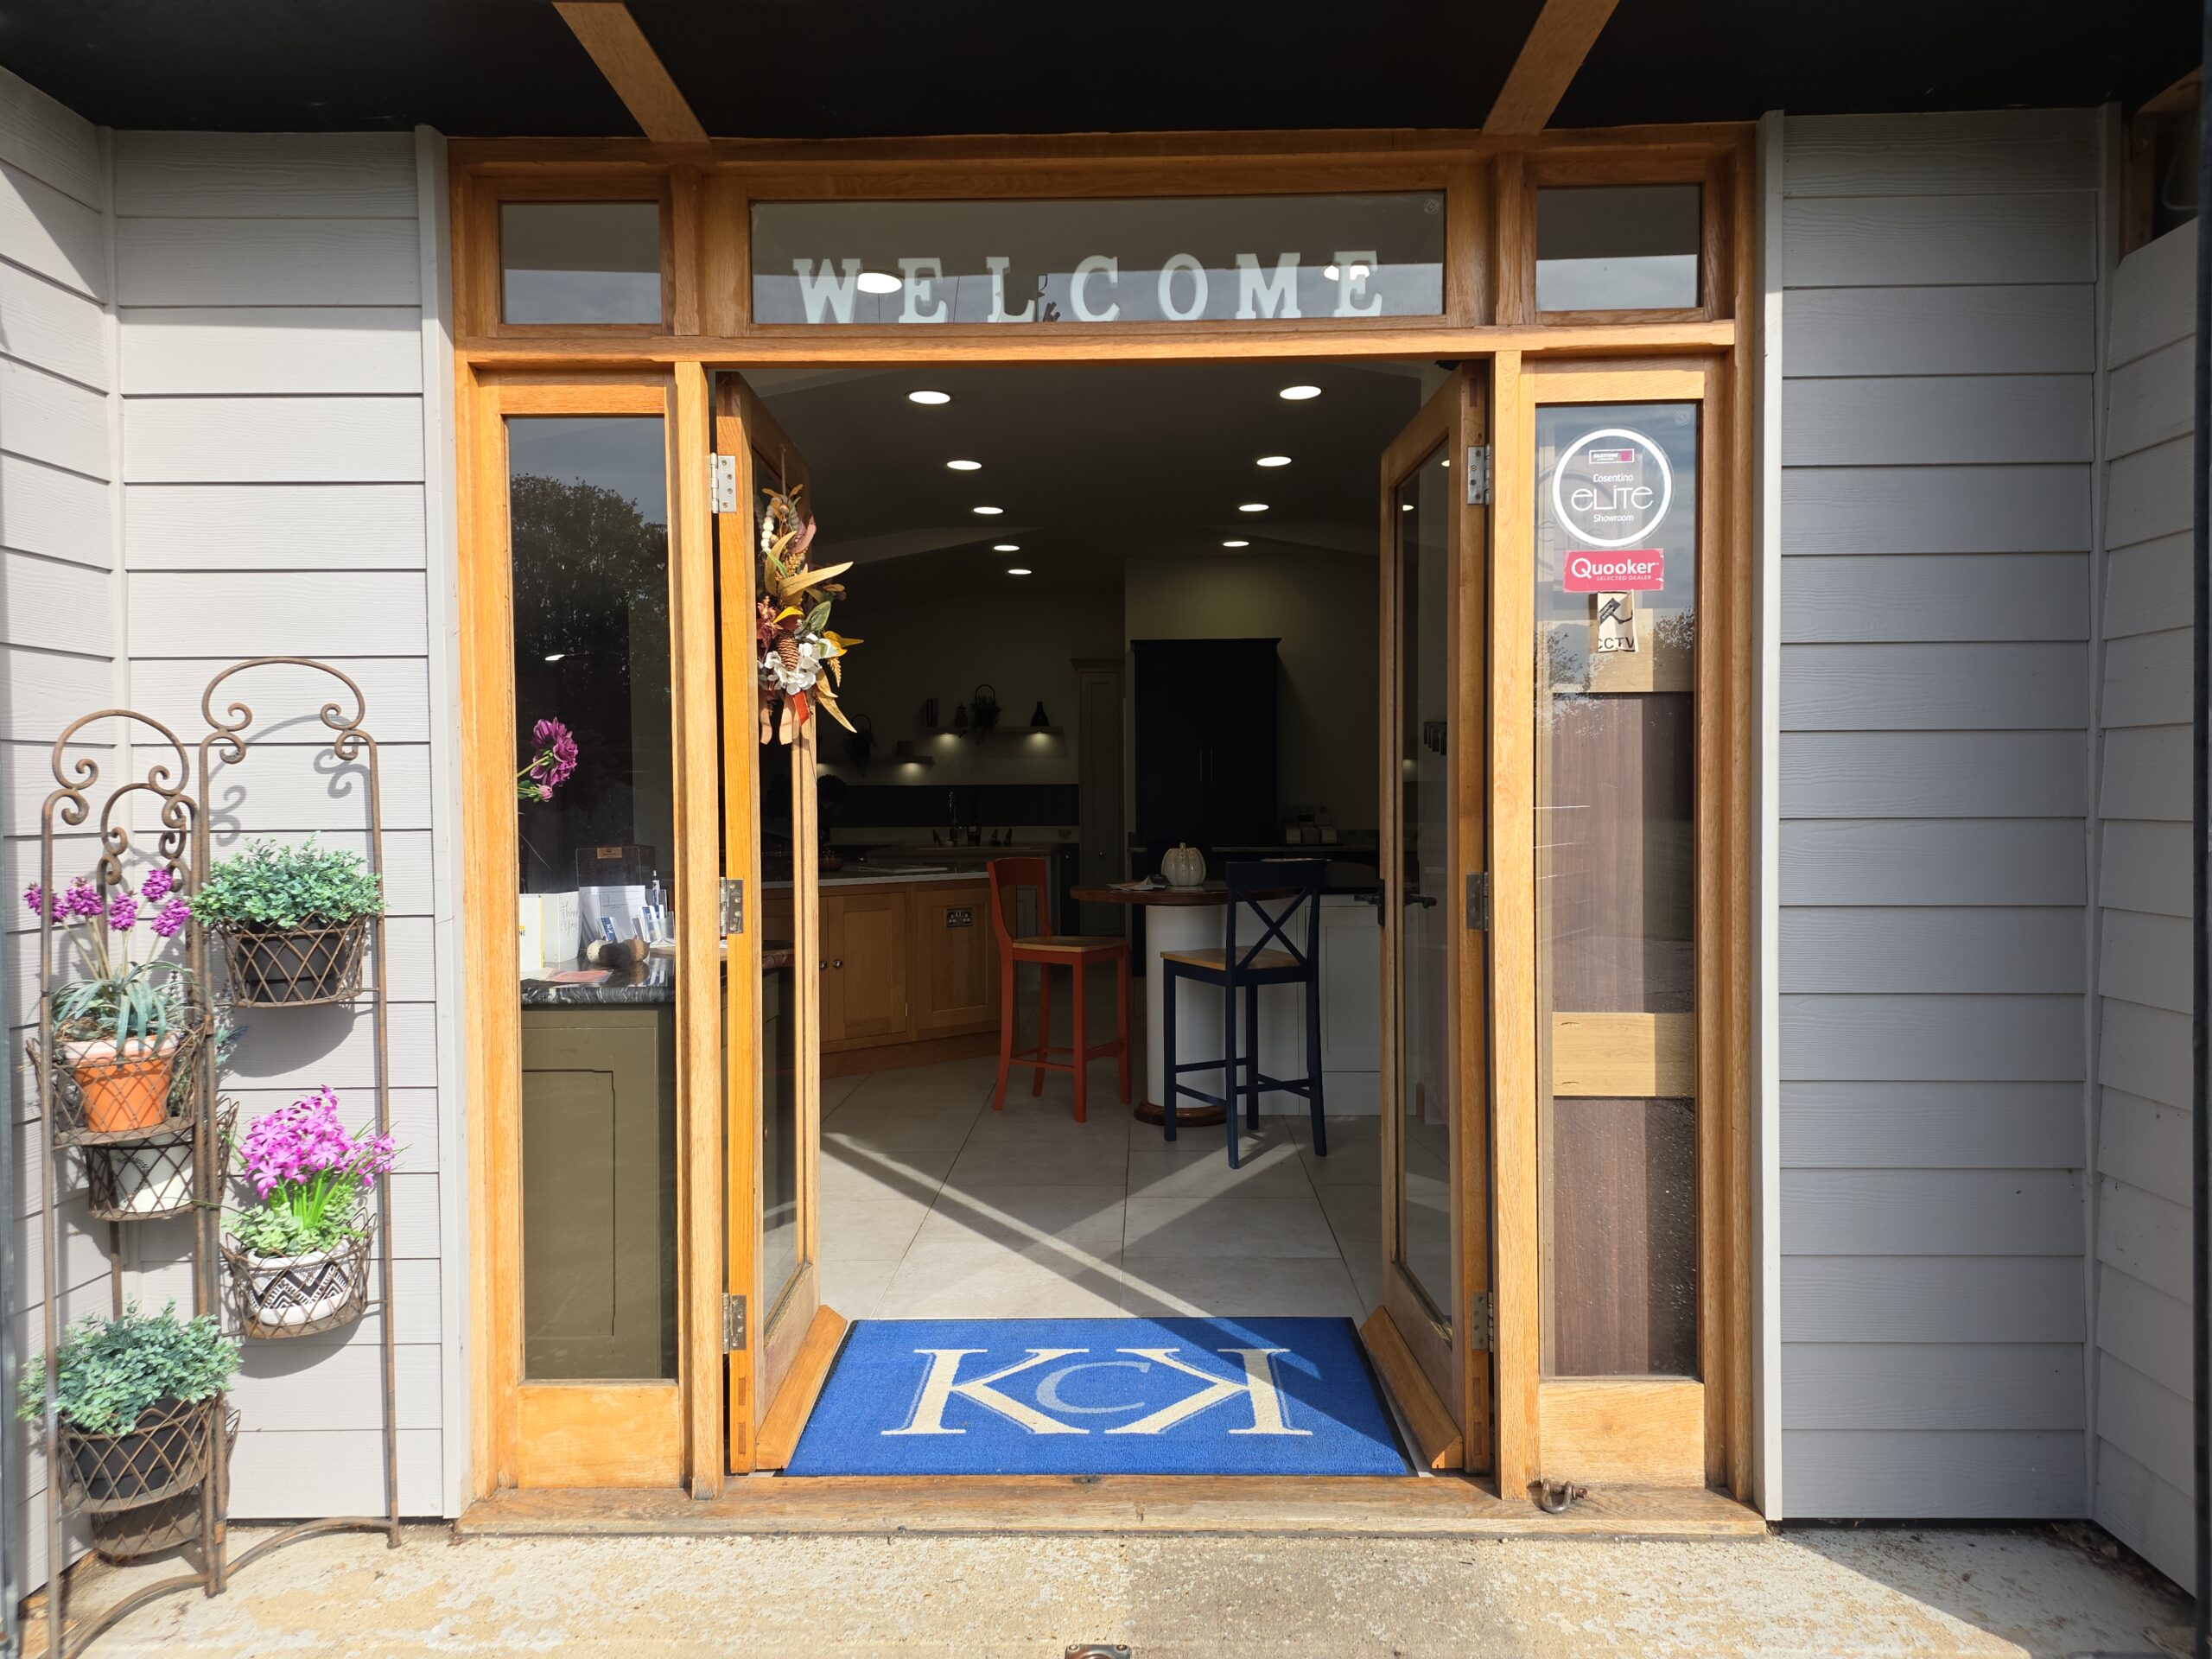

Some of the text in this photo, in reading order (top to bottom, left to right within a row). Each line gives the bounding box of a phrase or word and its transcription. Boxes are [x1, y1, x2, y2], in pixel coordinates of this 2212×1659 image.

[792, 249, 1383, 323] WELCOME
[1592, 473, 1634, 483] Cosentino
[1592, 513, 1635, 523] Showroom
[1571, 557, 1656, 579] Quooker
